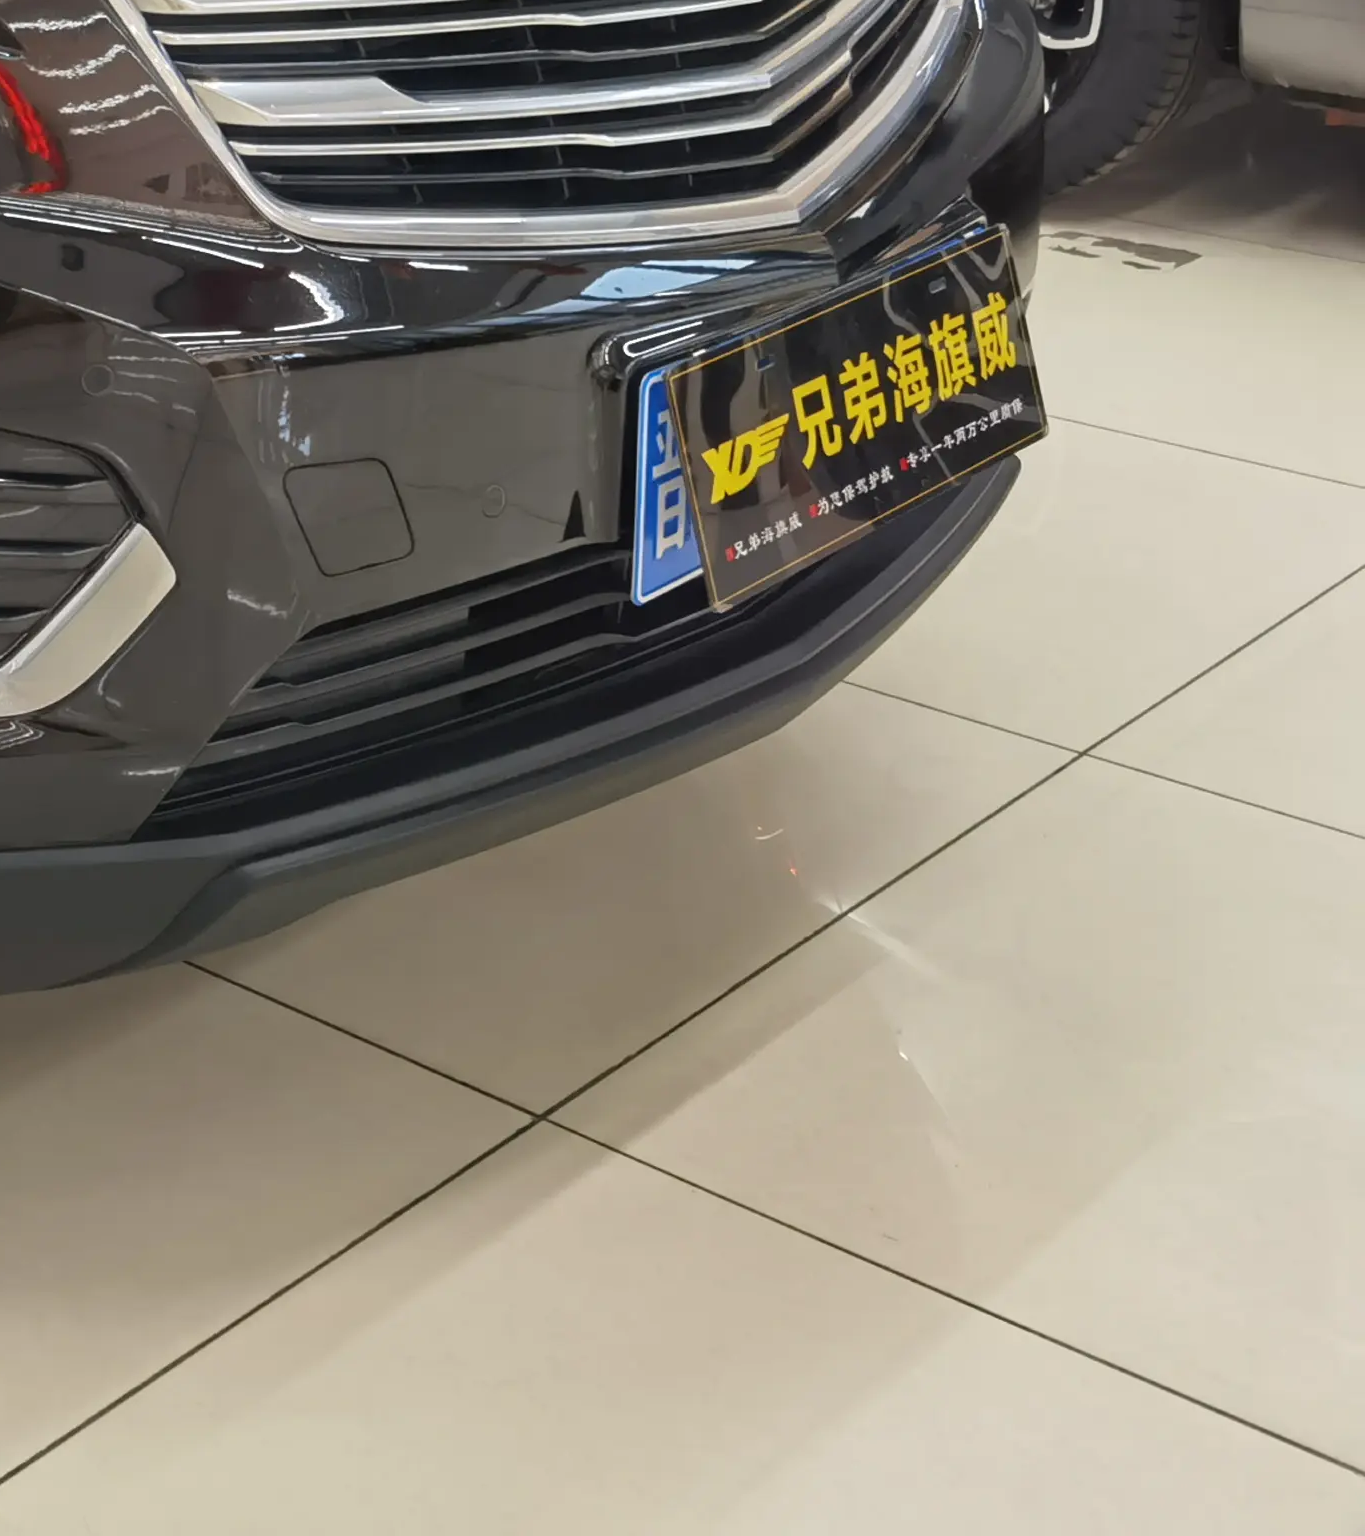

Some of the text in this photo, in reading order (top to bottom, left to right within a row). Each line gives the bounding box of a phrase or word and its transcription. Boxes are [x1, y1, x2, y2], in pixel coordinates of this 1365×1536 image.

[792, 292, 1018, 470] 兄弟海旗威
